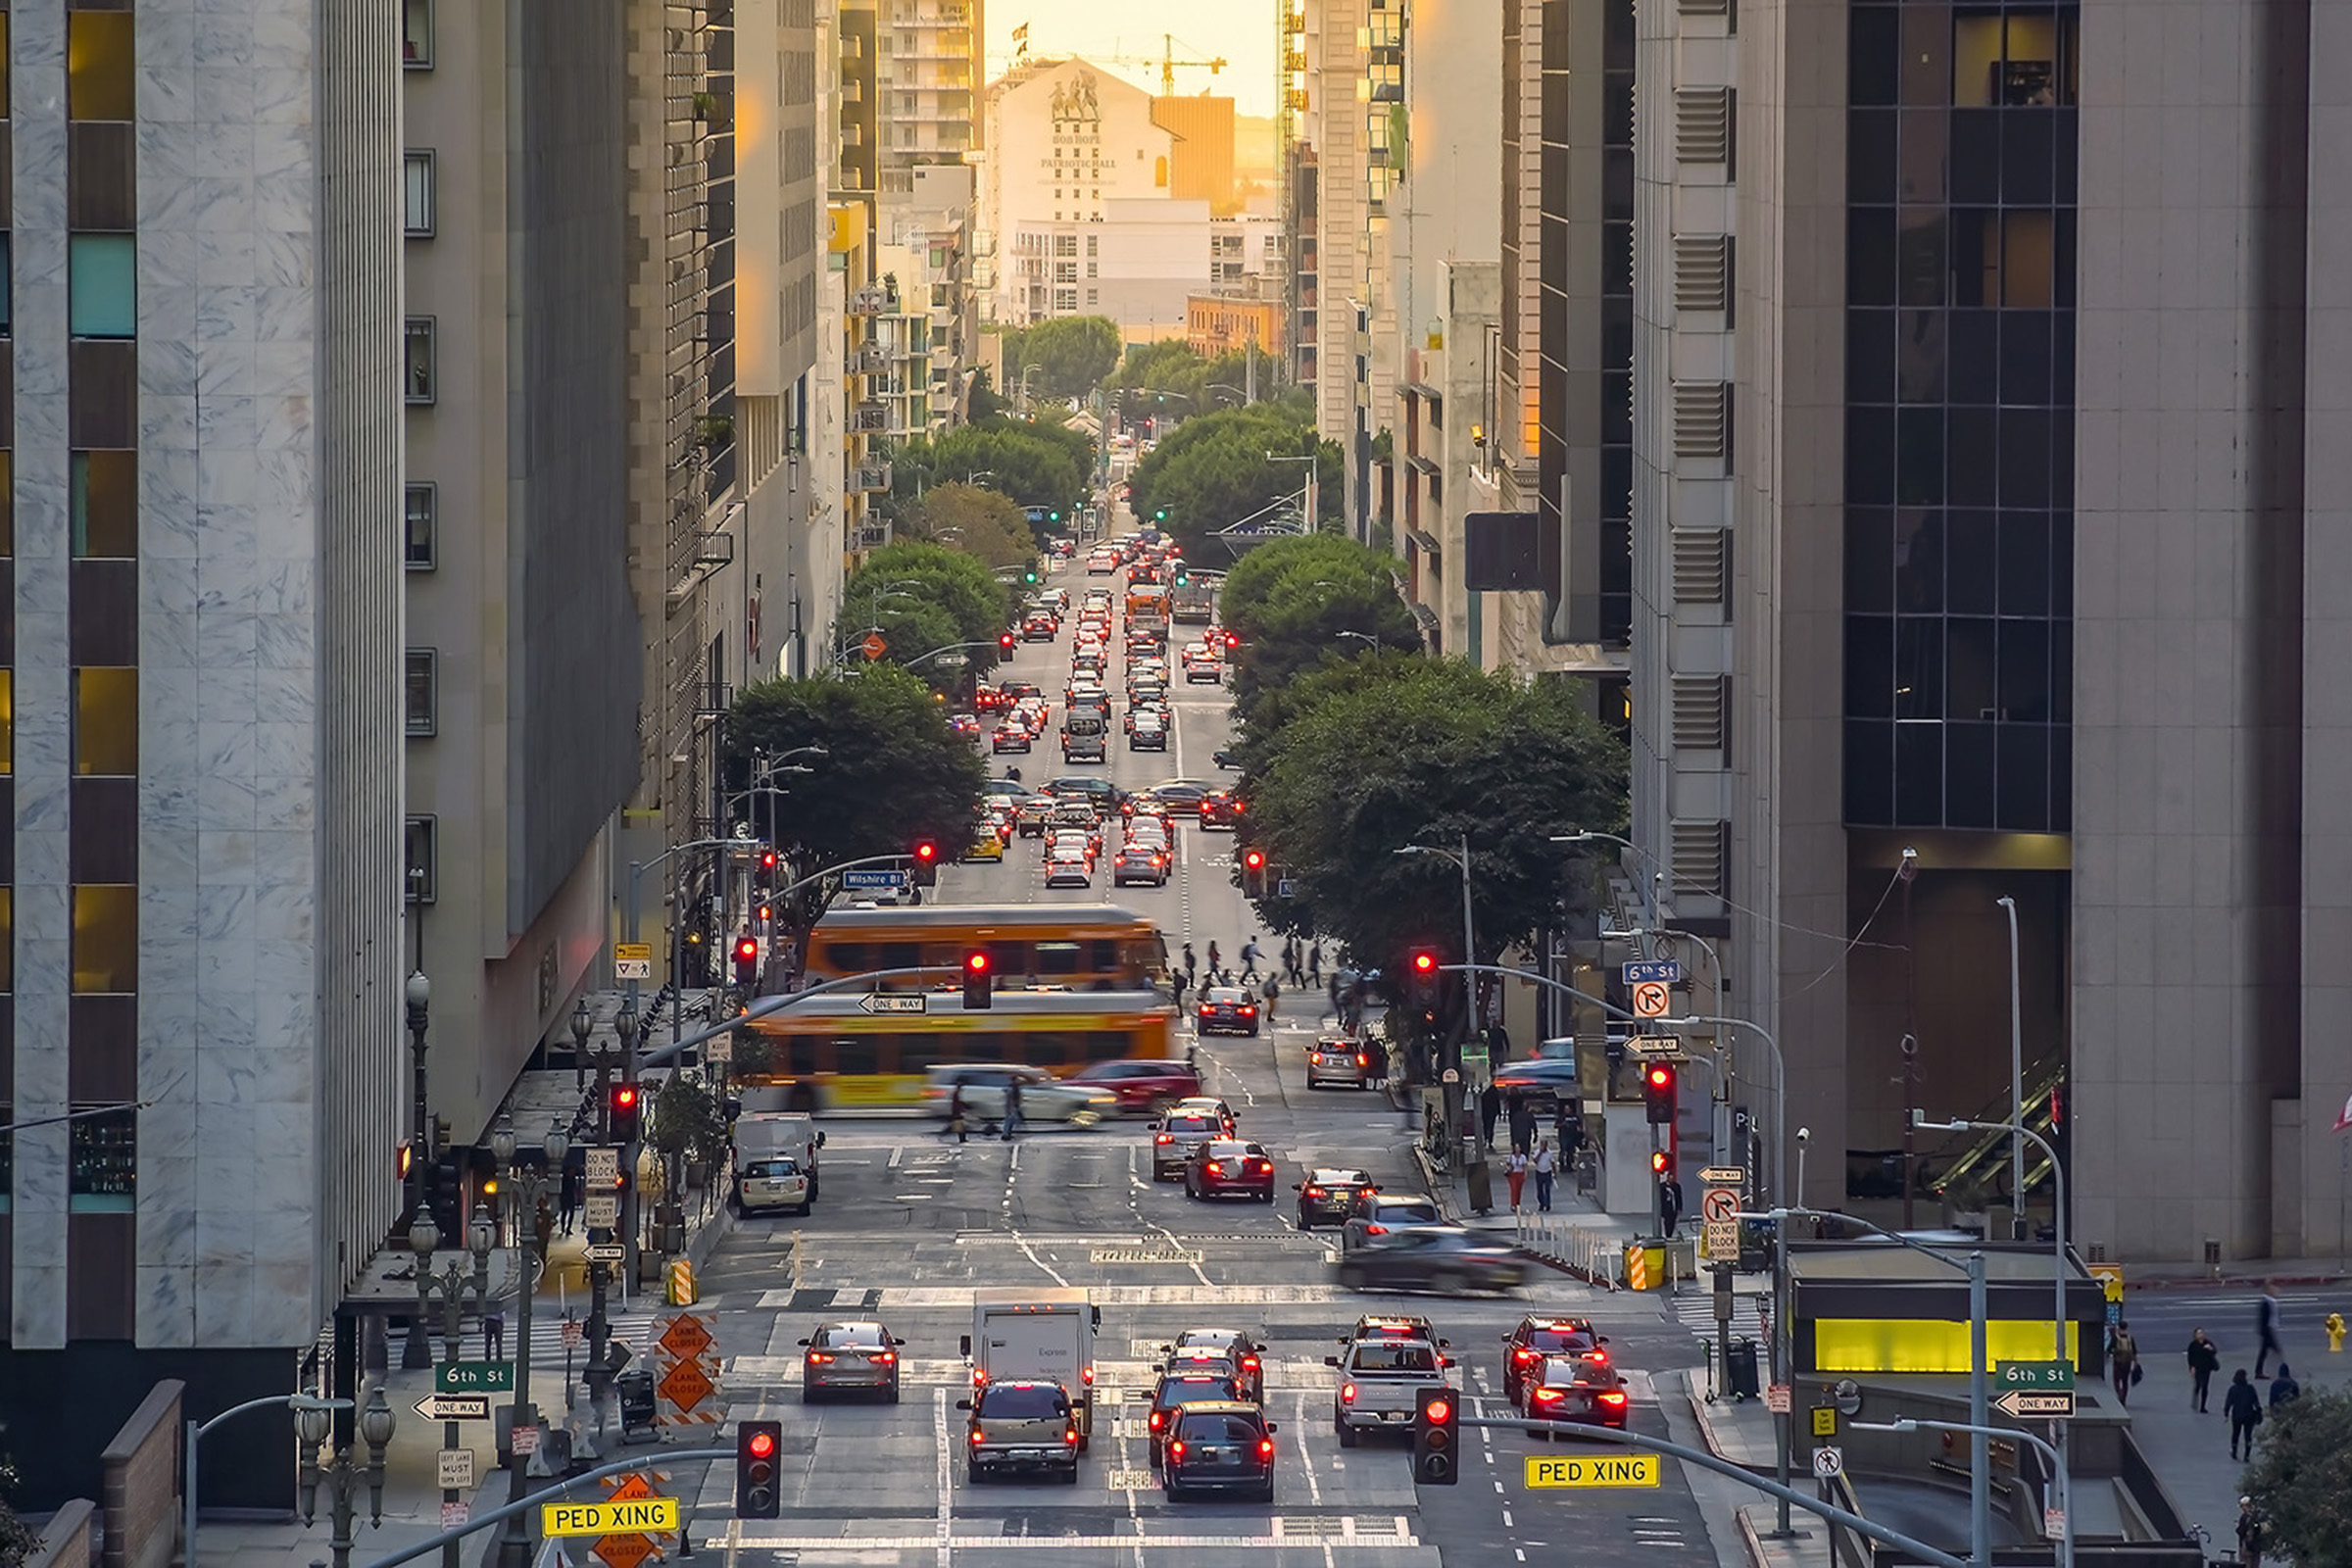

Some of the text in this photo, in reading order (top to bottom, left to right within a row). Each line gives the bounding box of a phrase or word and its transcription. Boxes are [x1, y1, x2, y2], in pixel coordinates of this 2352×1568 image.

[1041, 159, 1091, 169] PATRIOTIC
[848, 874, 886, 884] Wilshire
[1629, 965, 1674, 980] 6th St
[873, 1000, 919, 1009] ONE WAY
[587, 1154, 615, 1164] DO NOT
[587, 1167, 615, 1176] BLOCK
[1709, 1225, 1736, 1235] DO NOT
[1709, 1237, 1736, 1247] BLOCK
[668, 1339, 704, 1348] CLOSED
[446, 1367, 504, 1383] 6th St
[674, 1373, 697, 1382] LANE
[2006, 1366, 2064, 1382] 6th St
[668, 1384, 705, 1394] CLOSED
[434, 1402, 481, 1412] ONE WAY
[2019, 1399, 2066, 1408] ONE WAY
[443, 1464, 468, 1473] MUST
[1539, 1461, 1645, 1481] PED XING
[623, 1490, 648, 1499] LANE
[556, 1504, 664, 1529] PED XING
[604, 1545, 644, 1556] CLOSED
